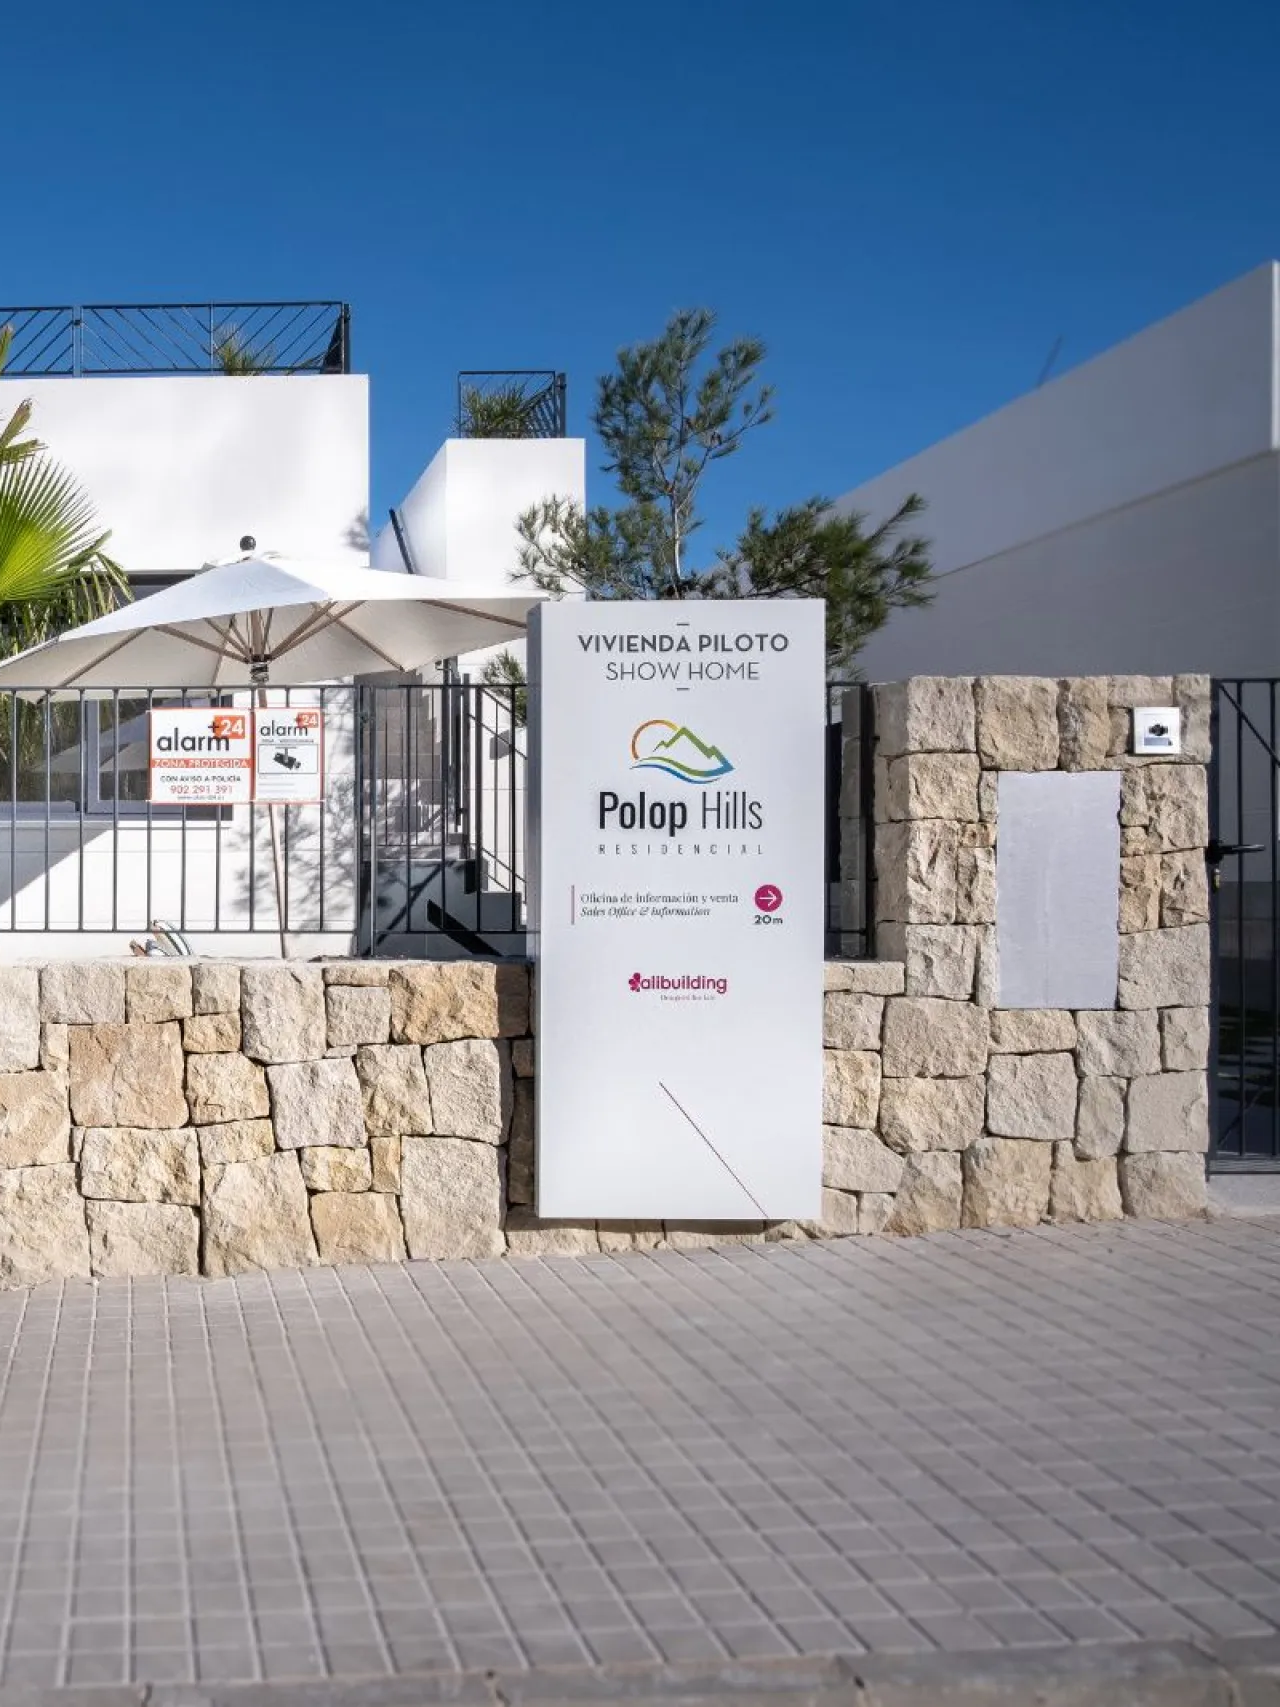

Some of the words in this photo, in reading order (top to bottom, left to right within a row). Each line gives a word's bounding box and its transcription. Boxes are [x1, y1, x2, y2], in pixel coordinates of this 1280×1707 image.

[578, 634, 691, 652] VIVIENDA
[698, 634, 789, 652] PILOTO
[606, 662, 680, 680] SHOW
[689, 662, 760, 680] HOME
[260, 720, 307, 736] alarm
[156, 727, 230, 751] alarm
[154, 759, 186, 768] ZONA
[188, 759, 248, 768] PROTEGIDA
[170, 785, 189, 794] 902
[192, 785, 210, 794] 291
[215, 785, 233, 794] 391
[599, 791, 687, 837] Polop
[702, 791, 763, 830] Hills
[599, 844, 763, 855] RESIDENCIAL
[620, 892, 632, 903] de
[641, 975, 728, 994] allbuilding
